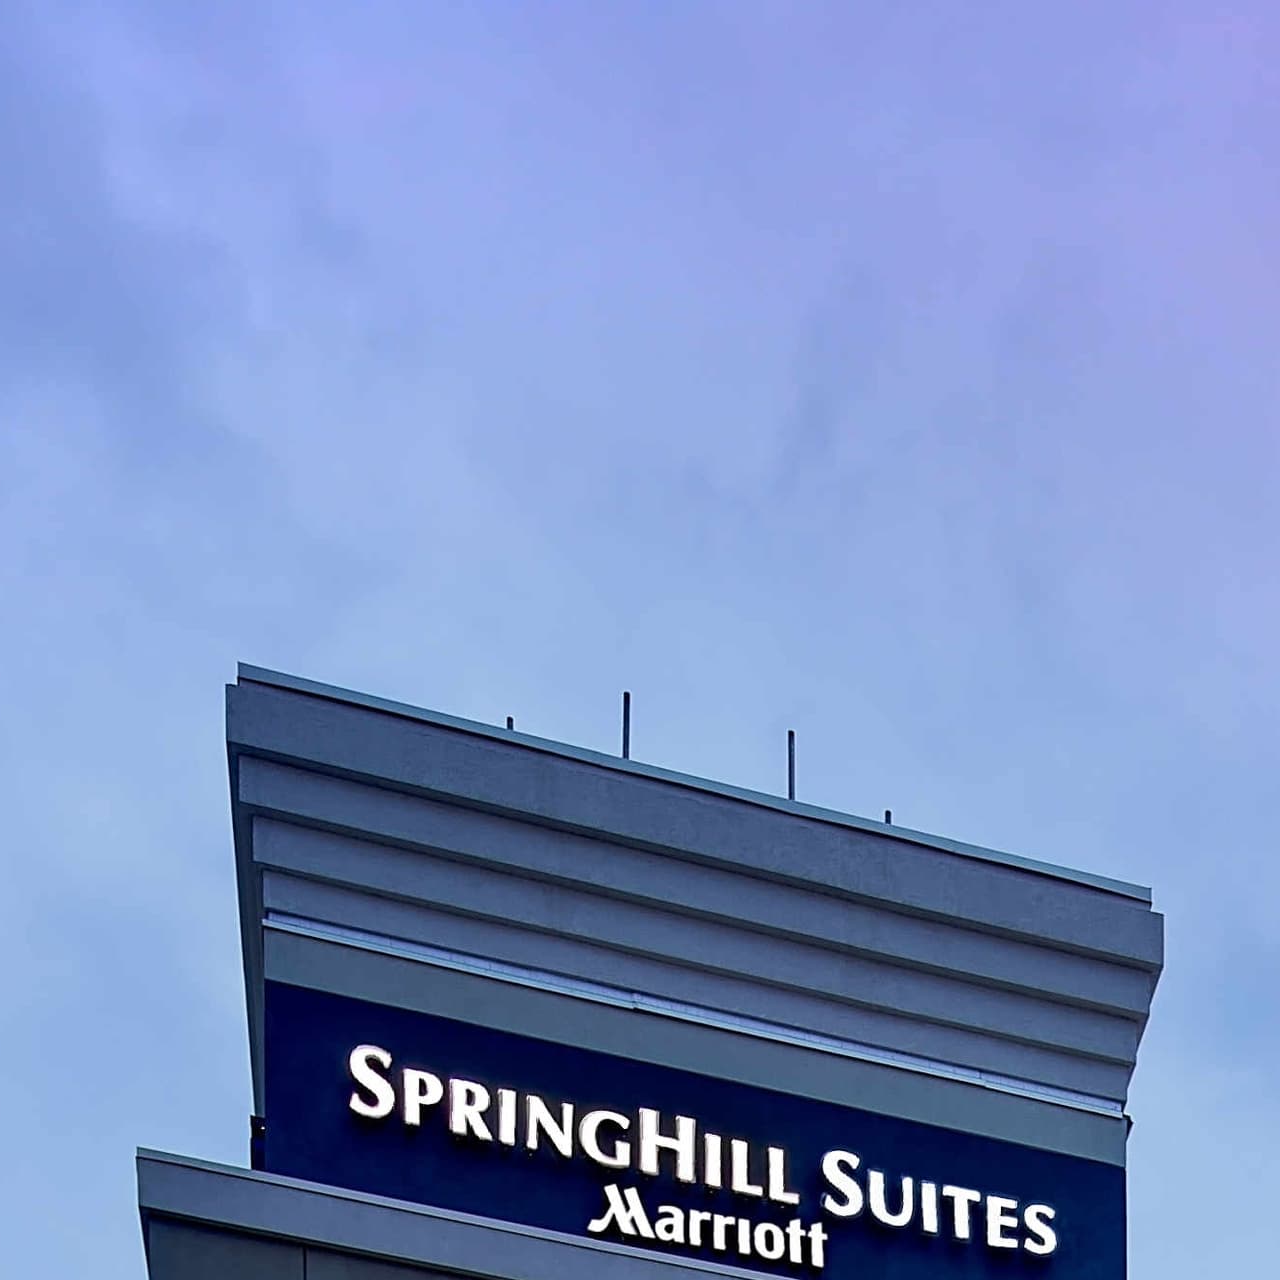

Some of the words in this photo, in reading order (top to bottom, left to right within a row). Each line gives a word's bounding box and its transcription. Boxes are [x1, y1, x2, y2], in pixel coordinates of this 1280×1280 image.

[348, 1043, 800, 1205] SPRINGHILL
[821, 1149, 1058, 1255] SUITES
[586, 1183, 829, 1269] Marriott
